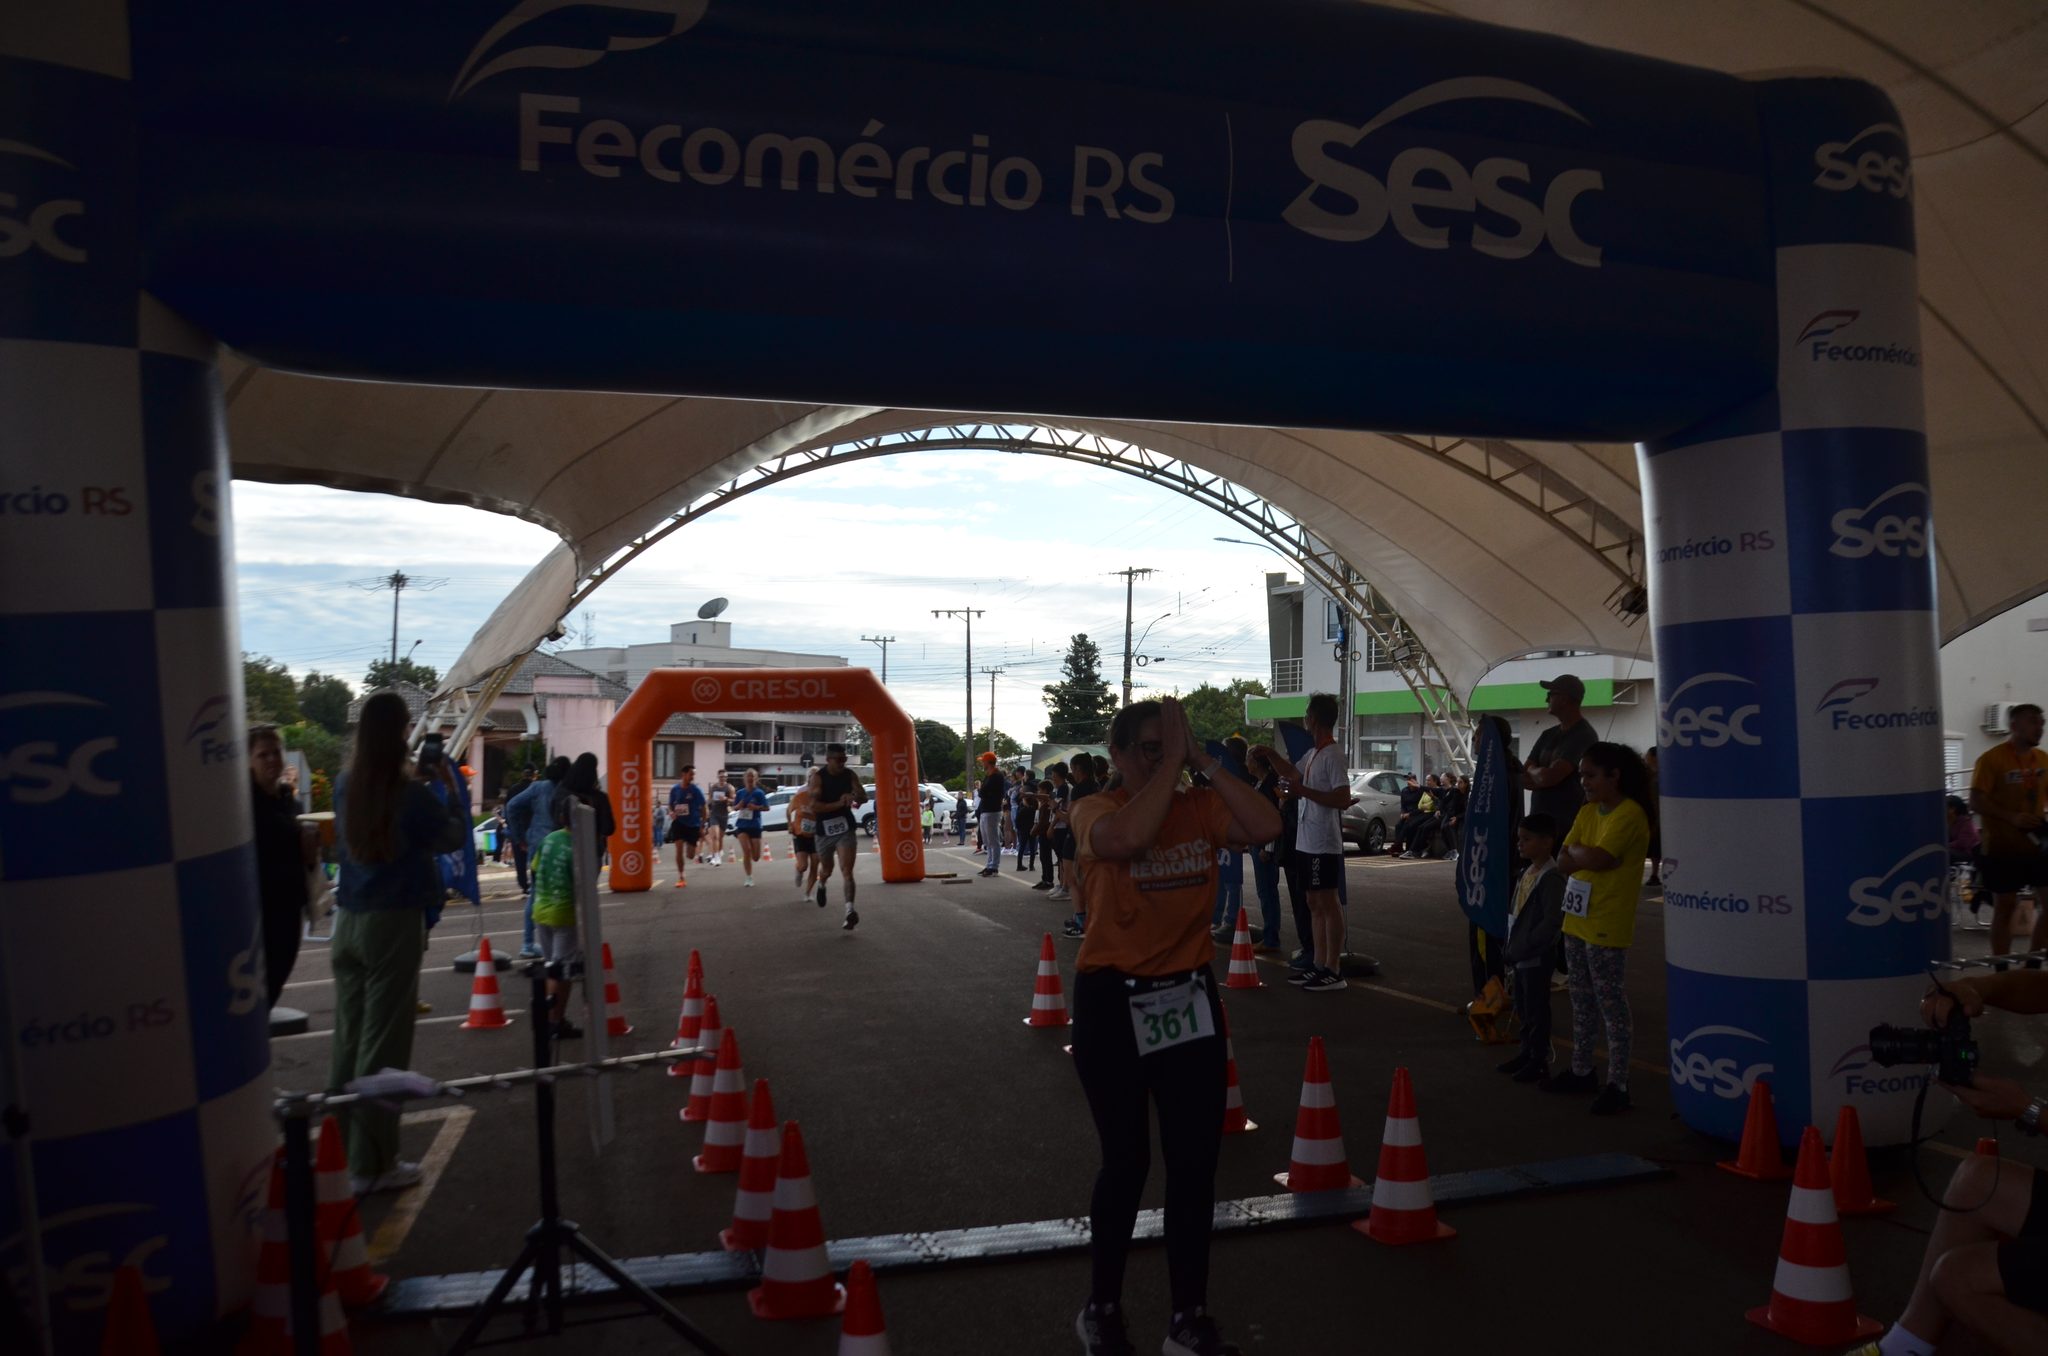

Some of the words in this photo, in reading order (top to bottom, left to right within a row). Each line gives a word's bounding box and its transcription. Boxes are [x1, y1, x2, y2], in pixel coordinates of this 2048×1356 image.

[518, 92, 1042, 212] Fecomércio
[1070, 145, 1176, 224] RS
[1812, 141, 1911, 199] Ses
[1281, 118, 1605, 269] Sesc
[81, 486, 135, 516] RS
[1656, 536, 1732, 565] omércio
[1739, 530, 1775, 552] RS
[1828, 507, 1929, 559] Ses
[730, 678, 837, 700] CRESOL
[622, 753, 641, 844] CRESOL
[892, 745, 914, 833] CRESOL
[1756, 894, 1793, 915] RS
[126, 998, 176, 1033] RS
[1142, 1001, 1199, 1047] 361
